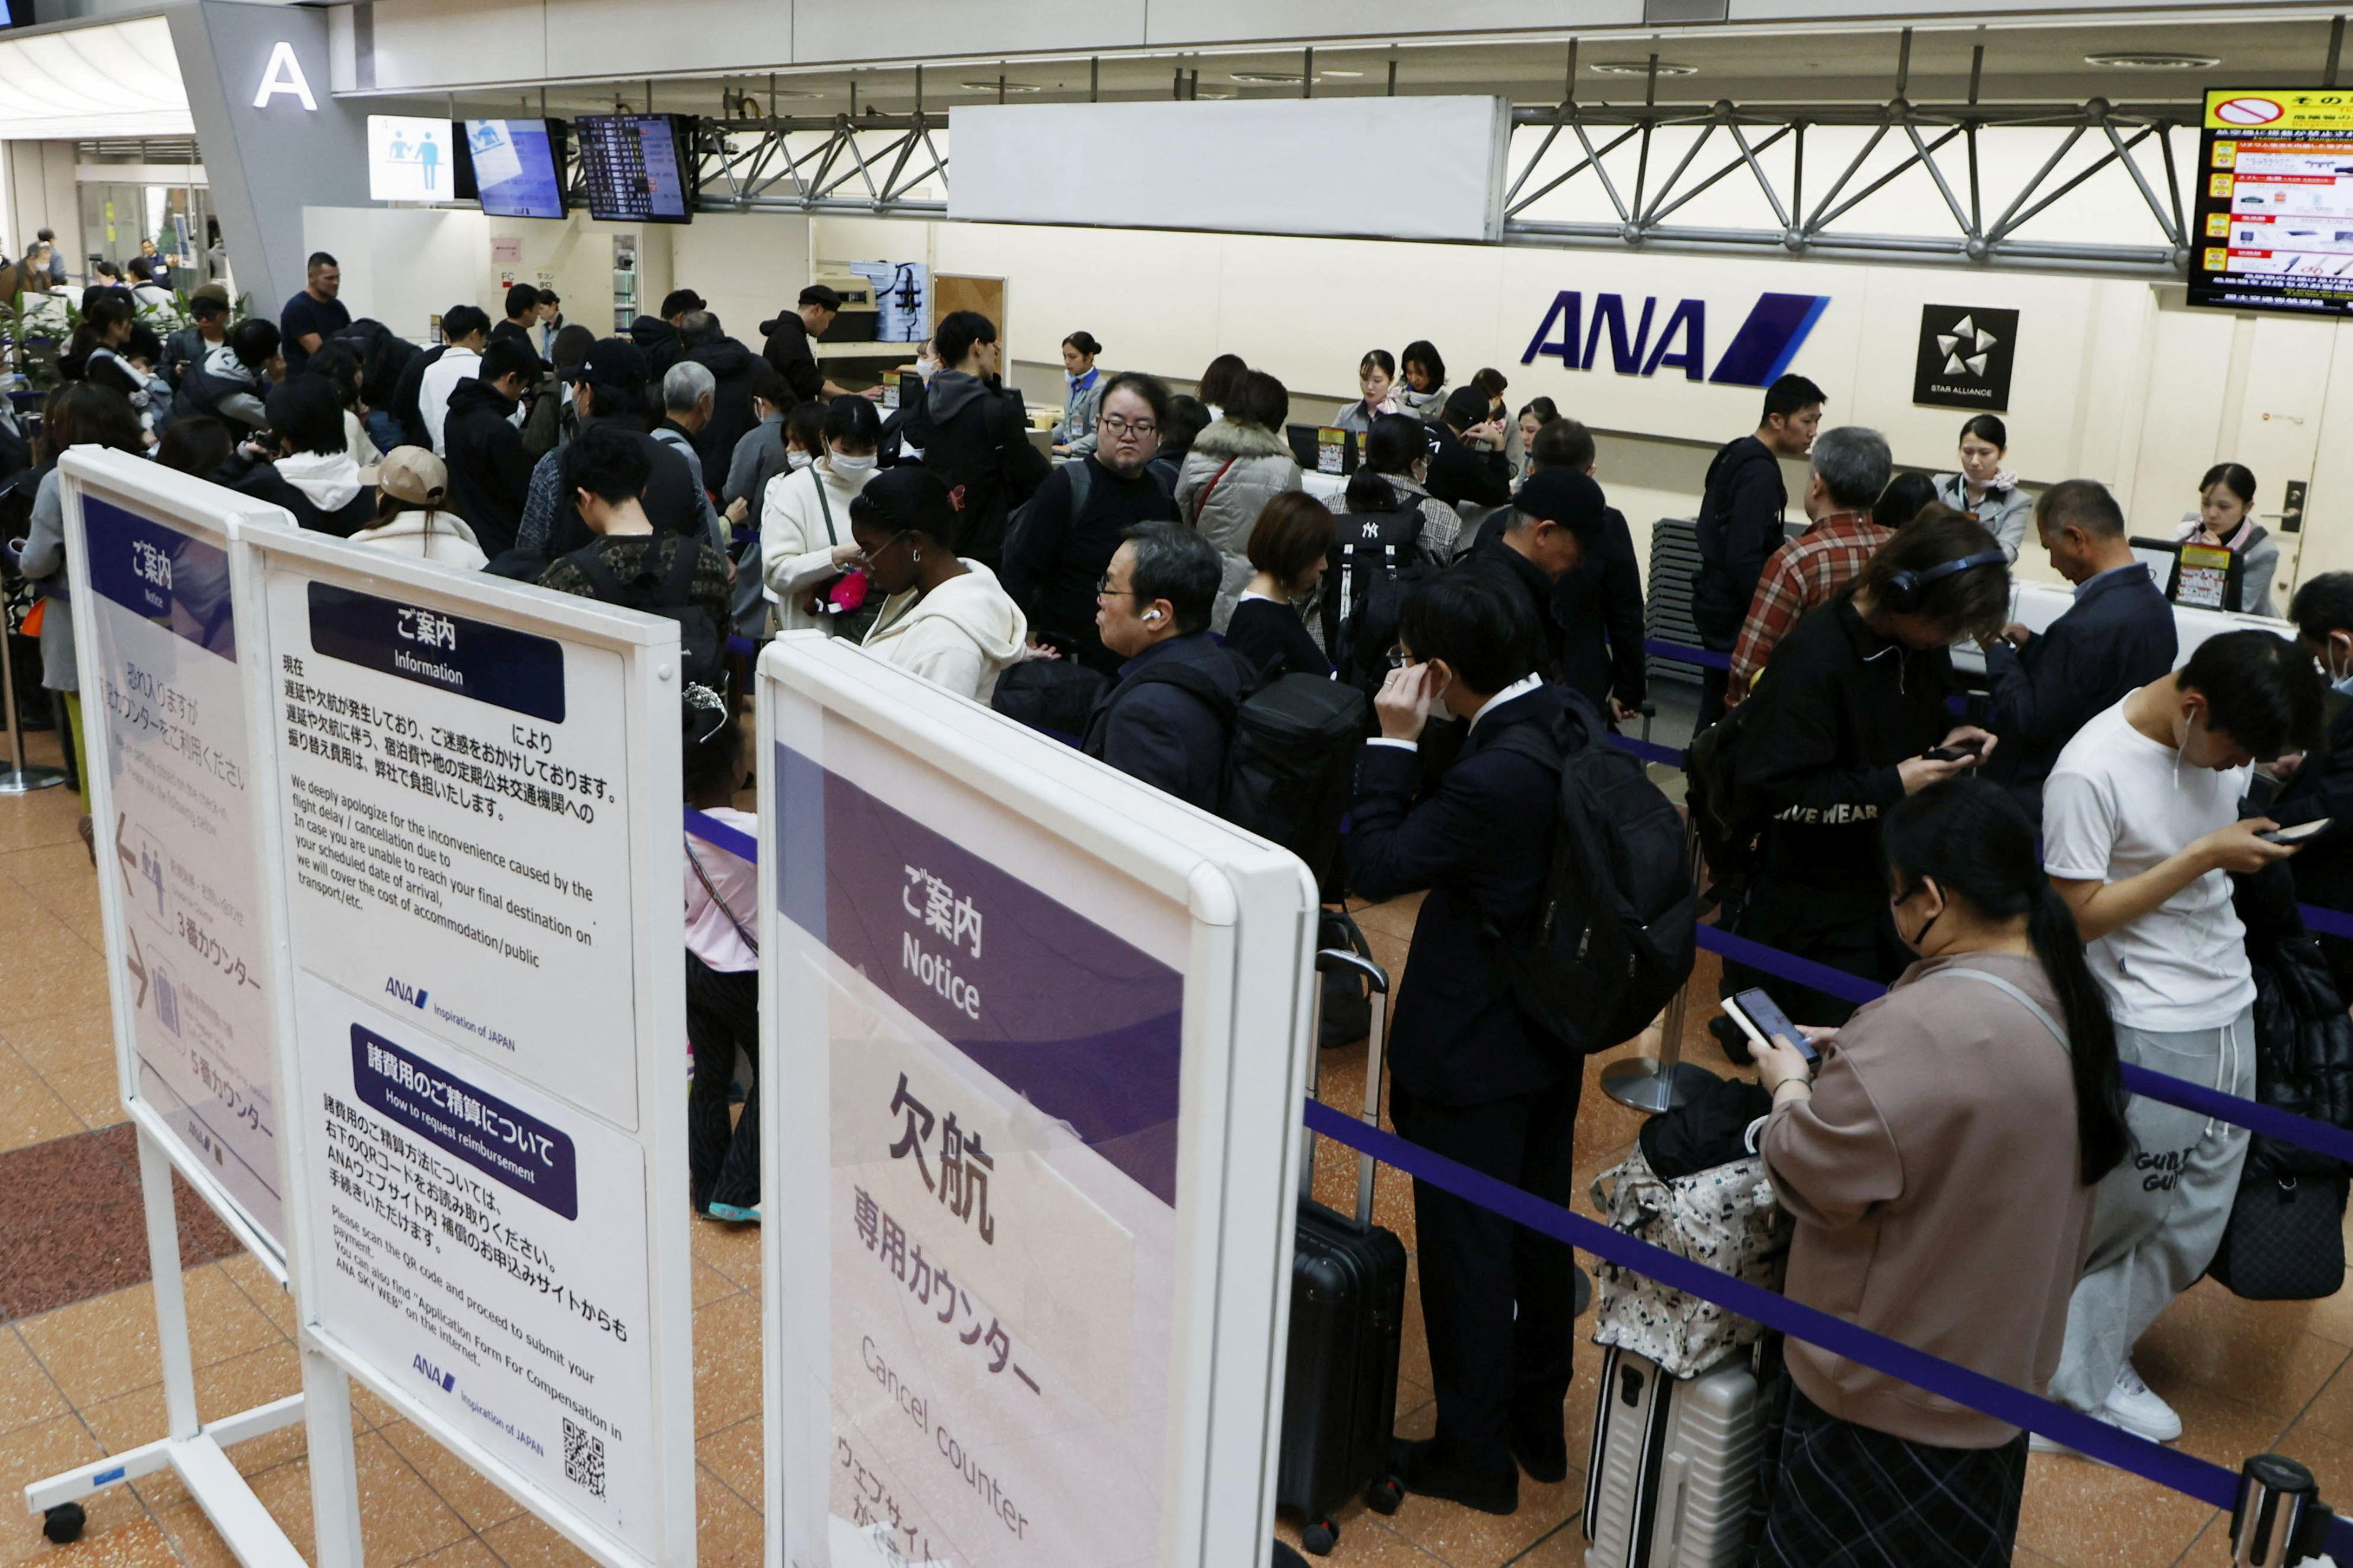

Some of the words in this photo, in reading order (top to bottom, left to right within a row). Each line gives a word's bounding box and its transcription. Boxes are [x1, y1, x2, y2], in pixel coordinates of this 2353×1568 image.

[253, 41, 318, 111] A
[1520, 290, 1706, 382] ANA
[1931, 384, 1951, 393] STAR
[1952, 387, 1992, 398] ALLIANCE
[132, 540, 173, 590] ご案内
[394, 649, 464, 685] Information
[397, 608, 456, 651] ご案内
[282, 653, 305, 678] 現在
[511, 723, 553, 755] により
[290, 773, 307, 792] We
[307, 780, 339, 807] deeply
[340, 794, 388, 823] apologize
[389, 810, 406, 829] for
[406, 817, 426, 838] the
[427, 824, 506, 869] inconvenience
[508, 858, 551, 886] caused
[553, 871, 569, 896] by
[571, 879, 594, 903] the
[291, 792, 317, 815] flight
[318, 804, 345, 829] delay
[346, 815, 352, 831] /
[354, 820, 415, 854] cancellation
[416, 842, 438, 863] due
[438, 850, 451, 868] to
[1822, 803, 1879, 825] WEAR
[293, 812, 305, 829] In
[306, 820, 328, 838] case
[329, 829, 347, 847] you
[349, 837, 366, 854] are
[368, 845, 403, 869] unable
[403, 857, 416, 874] to
[417, 865, 448, 887] reach
[449, 877, 476, 899] your
[477, 886, 503, 911] final
[505, 899, 573, 939] destination
[575, 929, 592, 947] on
[295, 834, 317, 852] your
[318, 844, 366, 873] scheduled
[368, 863, 391, 884] date
[392, 874, 404, 889] of
[405, 880, 443, 909] arrival,
[296, 853, 311, 869] we
[312, 860, 329, 877] will
[330, 868, 357, 888] cover
[358, 877, 376, 898] the
[377, 888, 399, 908] cost
[400, 897, 412, 912] of
[413, 903, 540, 969] accommodation/public
[297, 870, 364, 911] transport/etc.
[903, 864, 983, 958] ご案内
[177, 911, 261, 991] 3番カウンター
[385, 976, 414, 1005] ANA
[903, 930, 981, 1020] Notice
[433, 1002, 477, 1033] Inspiration
[477, 1025, 487, 1039] of
[487, 1029, 516, 1053] JAPAN
[366, 1041, 554, 1167] 諸費用のご精算について
[385, 1088, 408, 1112] How
[409, 1103, 420, 1119] to
[421, 1112, 457, 1141] request
[458, 1132, 535, 1184] reimbursement
[889, 1072, 995, 1246] 欠航
[333, 1223, 374, 1259] payment.
[331, 1203, 361, 1233] Please
[361, 1226, 384, 1248] scan
[384, 1240, 401, 1260] the
[402, 1251, 418, 1271] QR
[419, 1264, 444, 1288] code
[445, 1281, 465, 1302] and
[466, 1295, 509, 1331] proceed
[510, 1322, 524, 1340] to
[525, 1333, 566, 1367] submit
[567, 1359, 595, 1385] your
[336, 1256, 356, 1279] ANA
[356, 1270, 375, 1292] SKY
[405, 1307, 419, 1323] on
[420, 1314, 438, 1336] the
[439, 1326, 482, 1367] internet.
[853, 1186, 1042, 1398] 専用カウンター
[334, 1238, 352, 1260] You
[353, 1254, 369, 1272] can
[371, 1266, 391, 1287] also
[391, 1278, 412, 1301] find
[474, 1334, 503, 1364] Form
[505, 1354, 524, 1376] For
[525, 1368, 608, 1432] Compensation
[610, 1422, 623, 1442] in
[412, 1352, 441, 1387] ANA
[460, 1390, 505, 1430] Inspiration
[505, 1423, 515, 1437] of
[516, 1429, 544, 1458] JAPAN
[863, 1335, 928, 1434] Cancel
[936, 1426, 1028, 1540] counter
